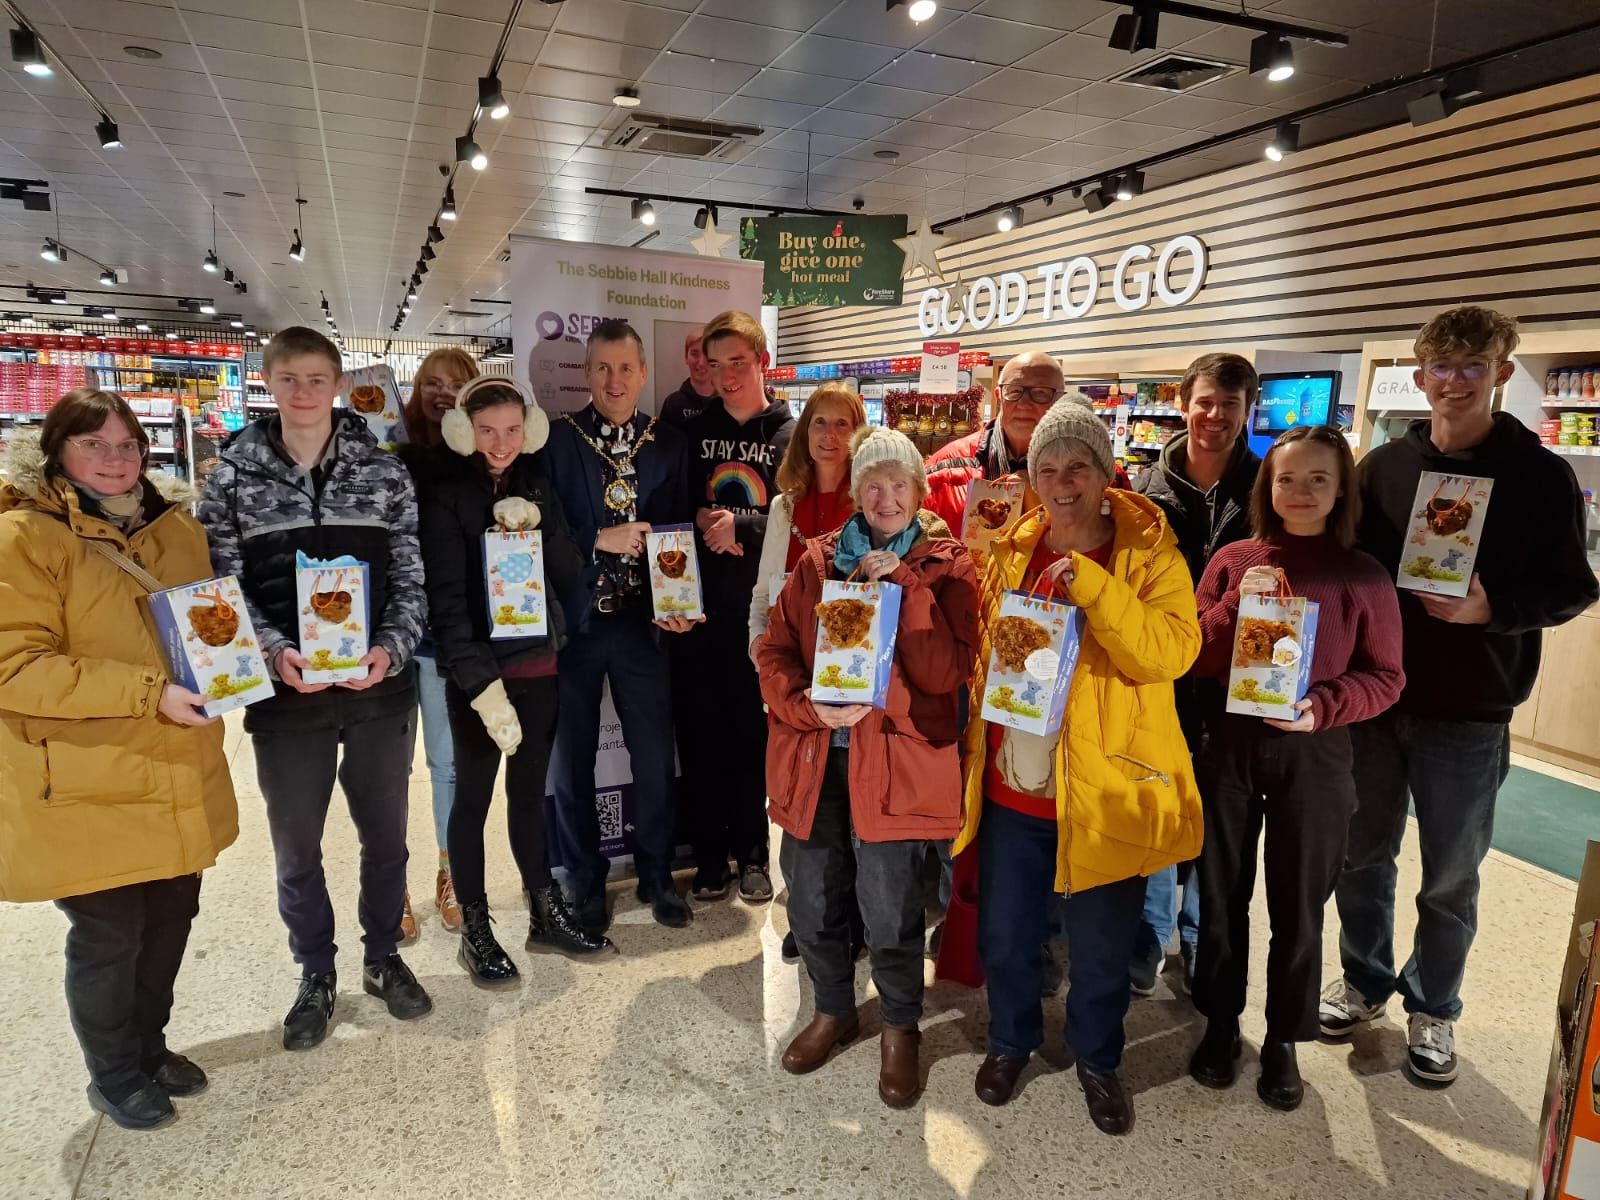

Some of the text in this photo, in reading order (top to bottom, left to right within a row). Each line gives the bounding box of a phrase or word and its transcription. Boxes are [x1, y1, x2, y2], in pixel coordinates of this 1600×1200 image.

[779, 232, 817, 253] Buy
[780, 251, 863, 273] give one
[557, 260, 731, 291] The Sebbie Hall Kindness
[791, 271, 851, 283] hot meal
[919, 235, 1209, 337] GOOD TO GO
[607, 290, 687, 310] Foundation
[700, 438, 735, 460] STAY
